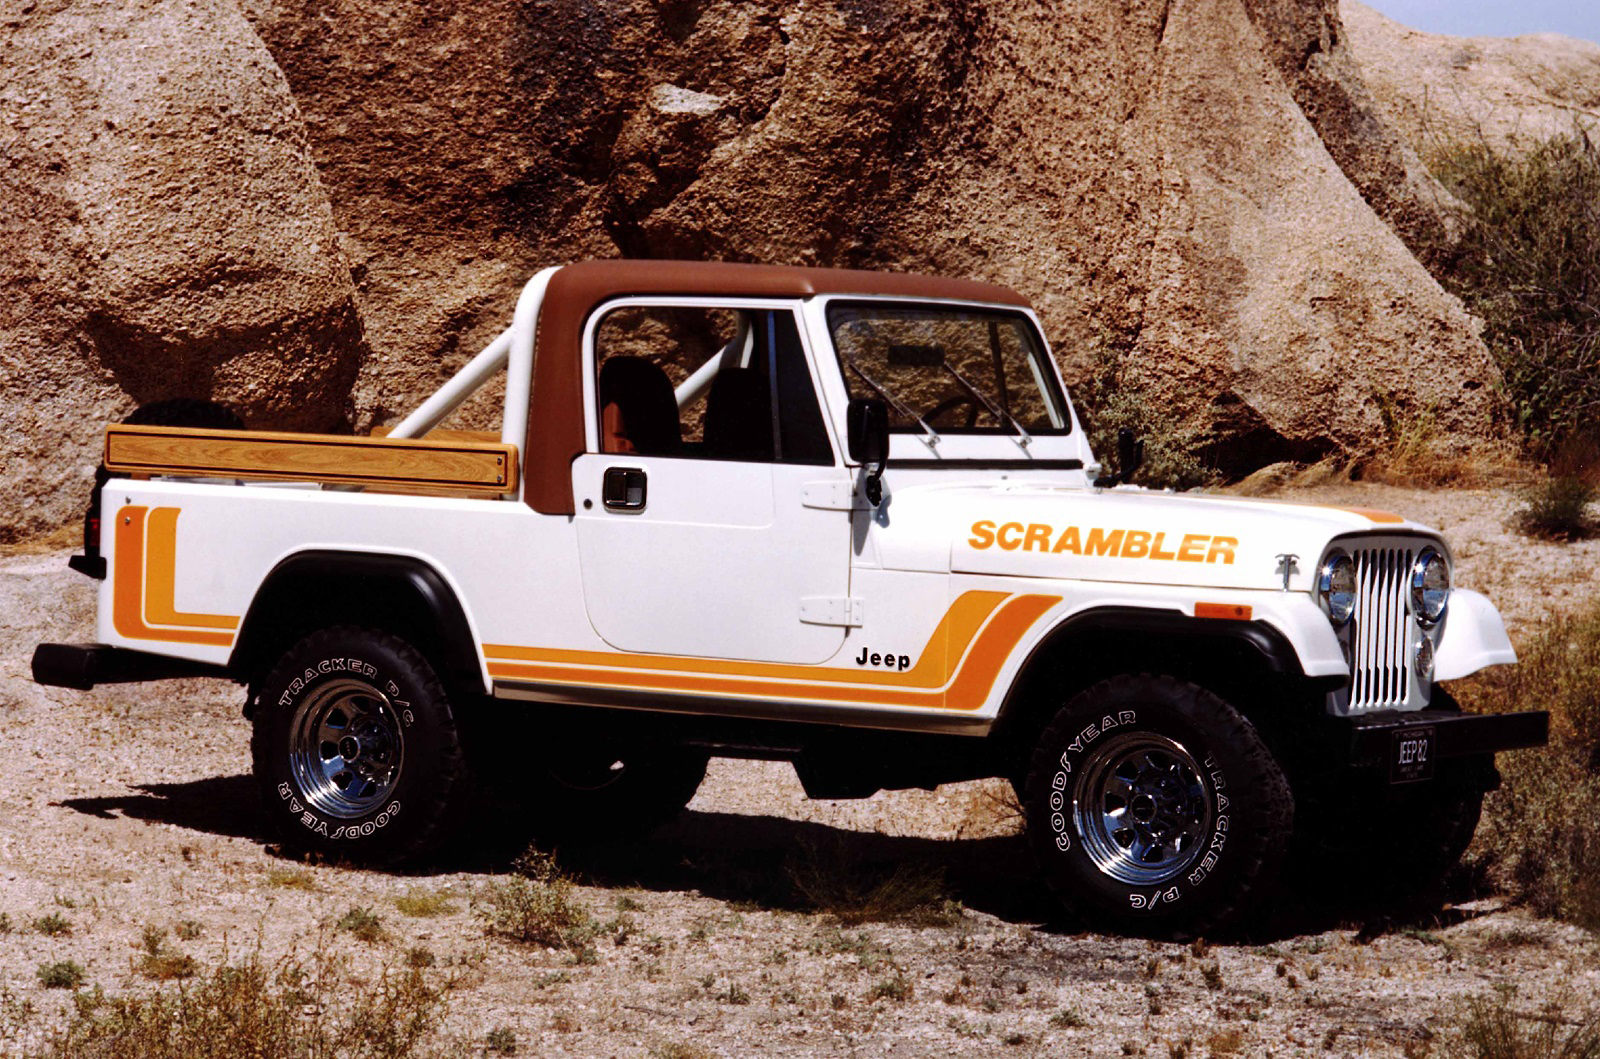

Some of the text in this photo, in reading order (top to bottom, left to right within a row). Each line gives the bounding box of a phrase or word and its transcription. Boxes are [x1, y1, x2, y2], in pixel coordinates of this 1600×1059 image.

[968, 519, 1239, 565] SCRAMBLER
[278, 658, 377, 707] TRACKER
[855, 647, 911, 671] Jeep
[1399, 739, 1428, 764] JEEP 82
[1050, 710, 1136, 852] GOODYEAR
[277, 781, 401, 839] GOODYEAR
[1188, 750, 1230, 886] TRACKER
